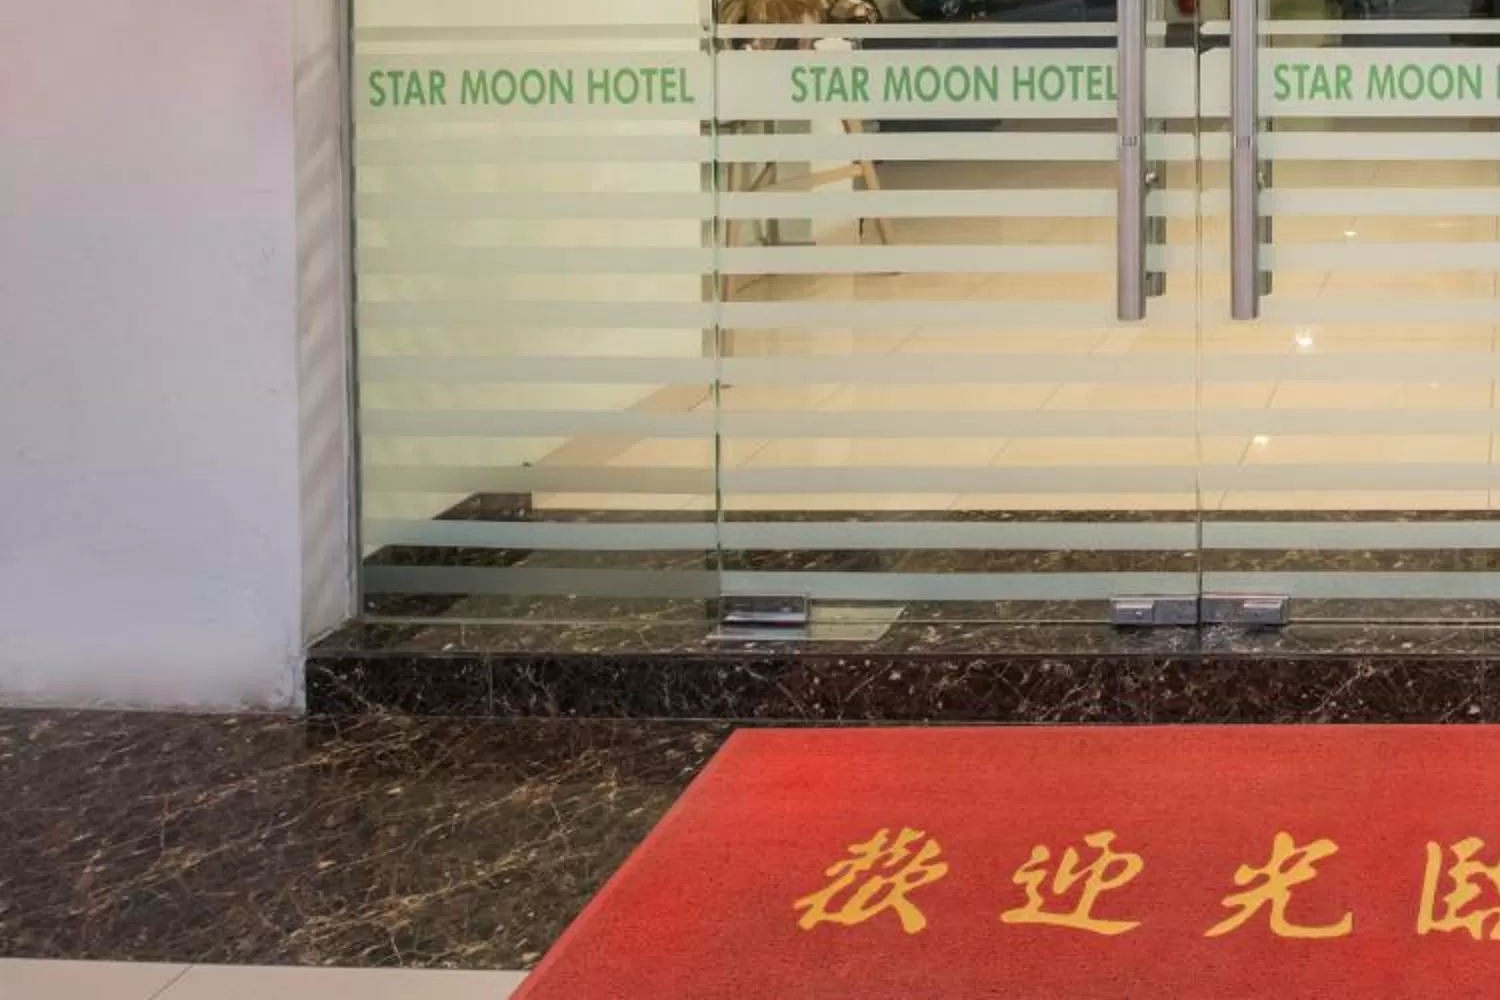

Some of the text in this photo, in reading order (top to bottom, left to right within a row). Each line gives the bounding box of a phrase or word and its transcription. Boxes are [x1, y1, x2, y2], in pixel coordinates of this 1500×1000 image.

[368, 67, 696, 107] STAR MOON HOTEL
[790, 64, 1120, 103] STAR MOON HOTEL
[1273, 63, 1353, 101] STAR
[1367, 63, 1483, 101] MOON
